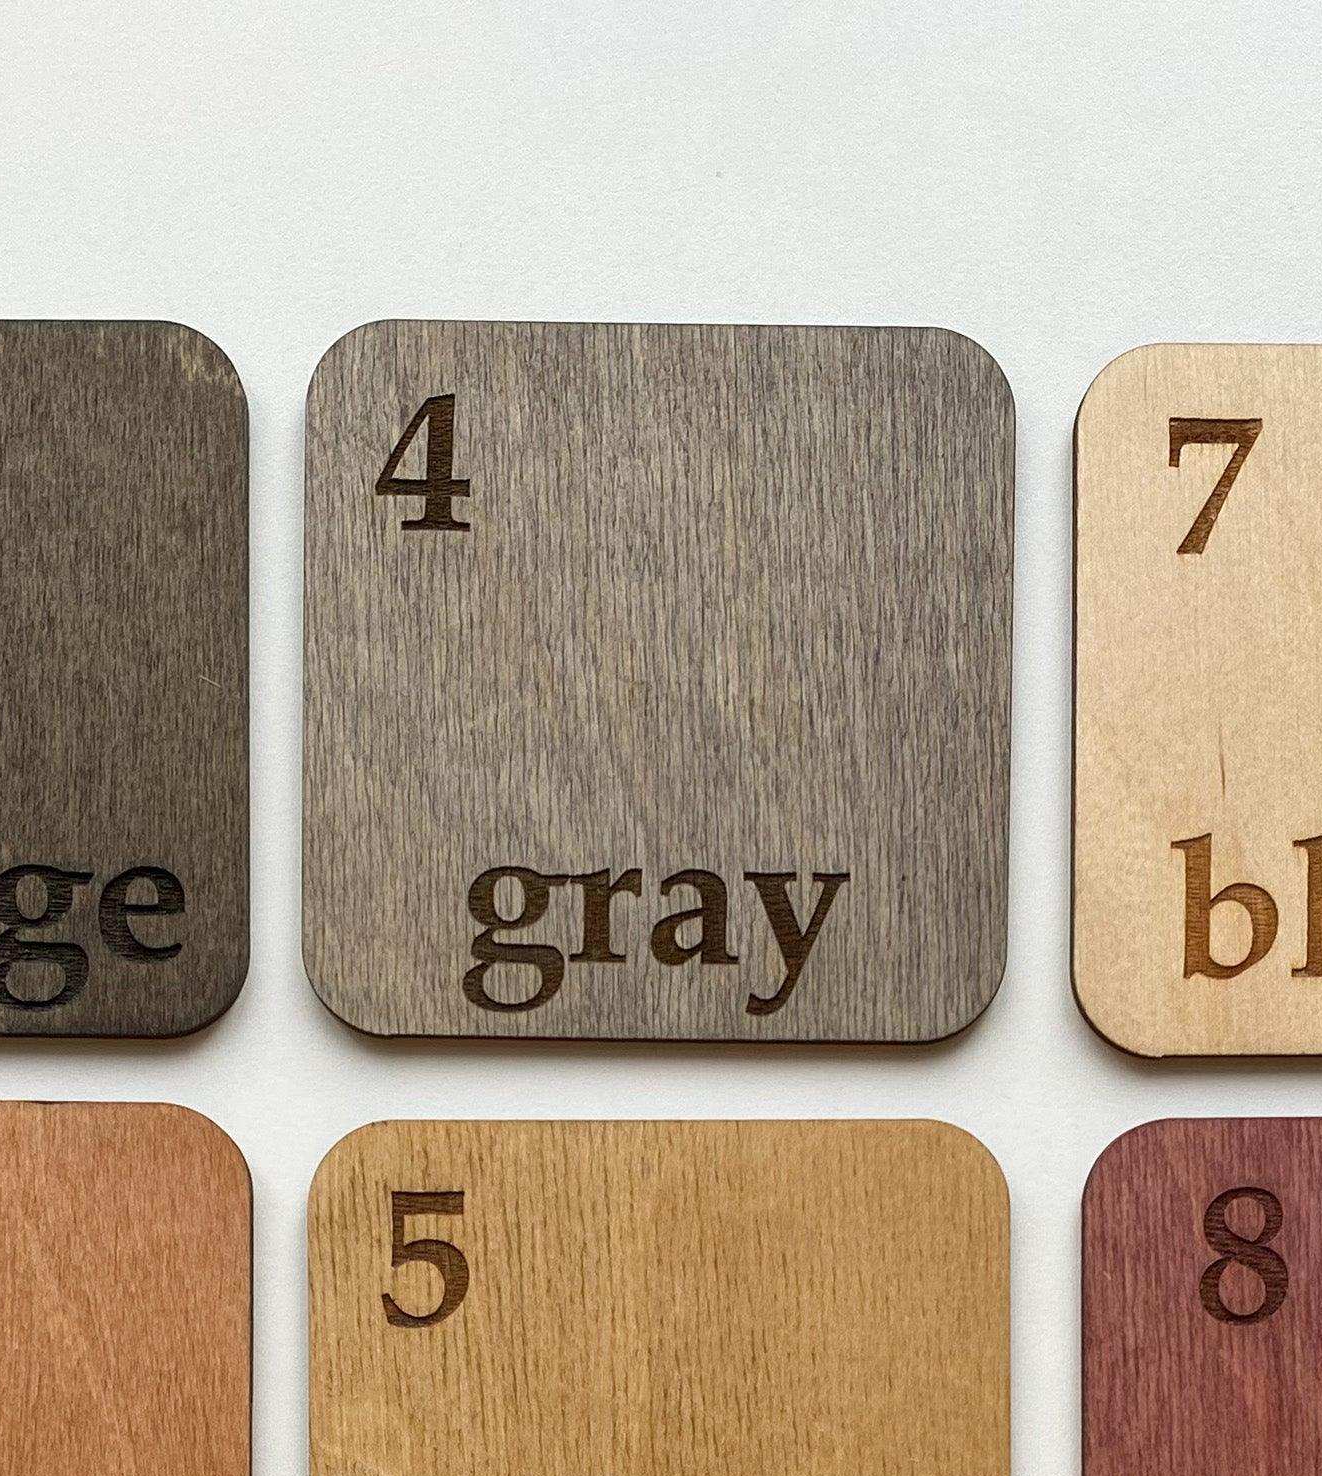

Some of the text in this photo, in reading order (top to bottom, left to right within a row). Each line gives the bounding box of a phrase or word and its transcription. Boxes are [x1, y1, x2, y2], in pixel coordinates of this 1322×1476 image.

[375, 394, 470, 531] 4
[1168, 416, 1262, 555] 7
[462, 866, 849, 1018] gray
[382, 1188, 469, 1328] 5
[1199, 1184, 1288, 1327] 8
